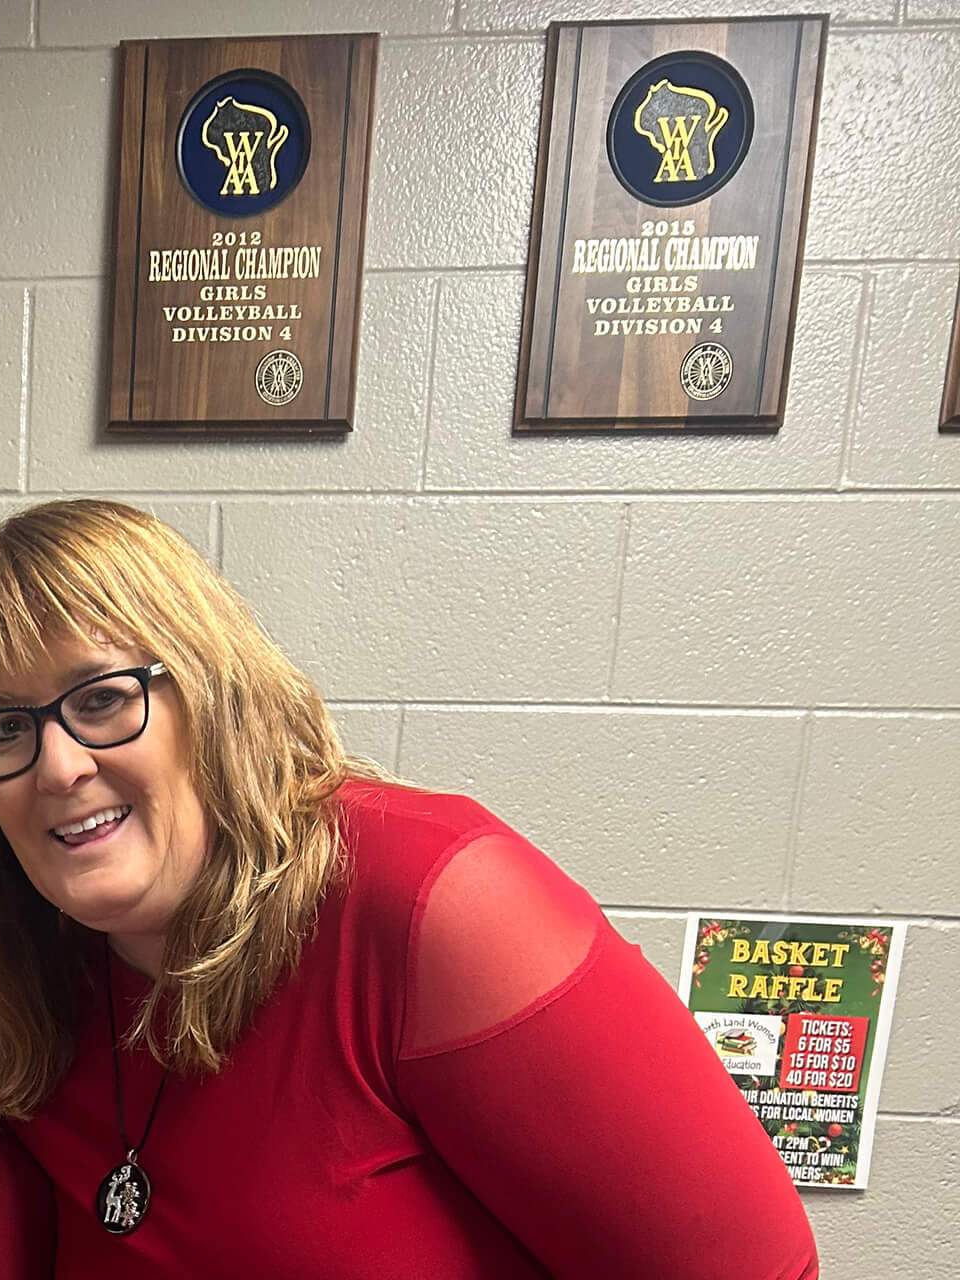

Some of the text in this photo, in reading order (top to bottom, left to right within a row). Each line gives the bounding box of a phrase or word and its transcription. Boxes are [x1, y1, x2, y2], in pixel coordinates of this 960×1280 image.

[212, 231, 262, 247] 2012
[572, 235, 760, 273] REGIONAL CHAMPION
[148, 247, 322, 282] REGIONAL CHAMPION
[200, 285, 267, 301] GIRLS
[626, 276, 698, 293] GIRLS
[162, 304, 302, 321] VOLLEYBALL
[586, 296, 735, 314] VOLLEYBALL
[172, 326, 292, 342] DIVISION 4
[594, 318, 723, 336] DIVISION 4
[730, 938, 850, 968] BASKET
[727, 974, 843, 1003] RAFFLE
[704, 1018, 776, 1044] orth Land Women
[802, 1020, 852, 1036] TICKETS:
[798, 1037, 850, 1053] 6 FOR $5
[790, 1053, 855, 1070] 15 FOR $10
[786, 1070, 852, 1087] 40 FOR $20
[760, 1091, 808, 1105] DONATION
[810, 1093, 858, 1108] BENEFITS
[761, 1106, 781, 1119] FOR
[783, 1107, 814, 1121] LOCAL
[816, 1109, 854, 1123] WOMEN
[772, 1136, 809, 1150] AT 2PM
[807, 1152, 819, 1165] TO
[821, 1153, 844, 1167] WIN!
